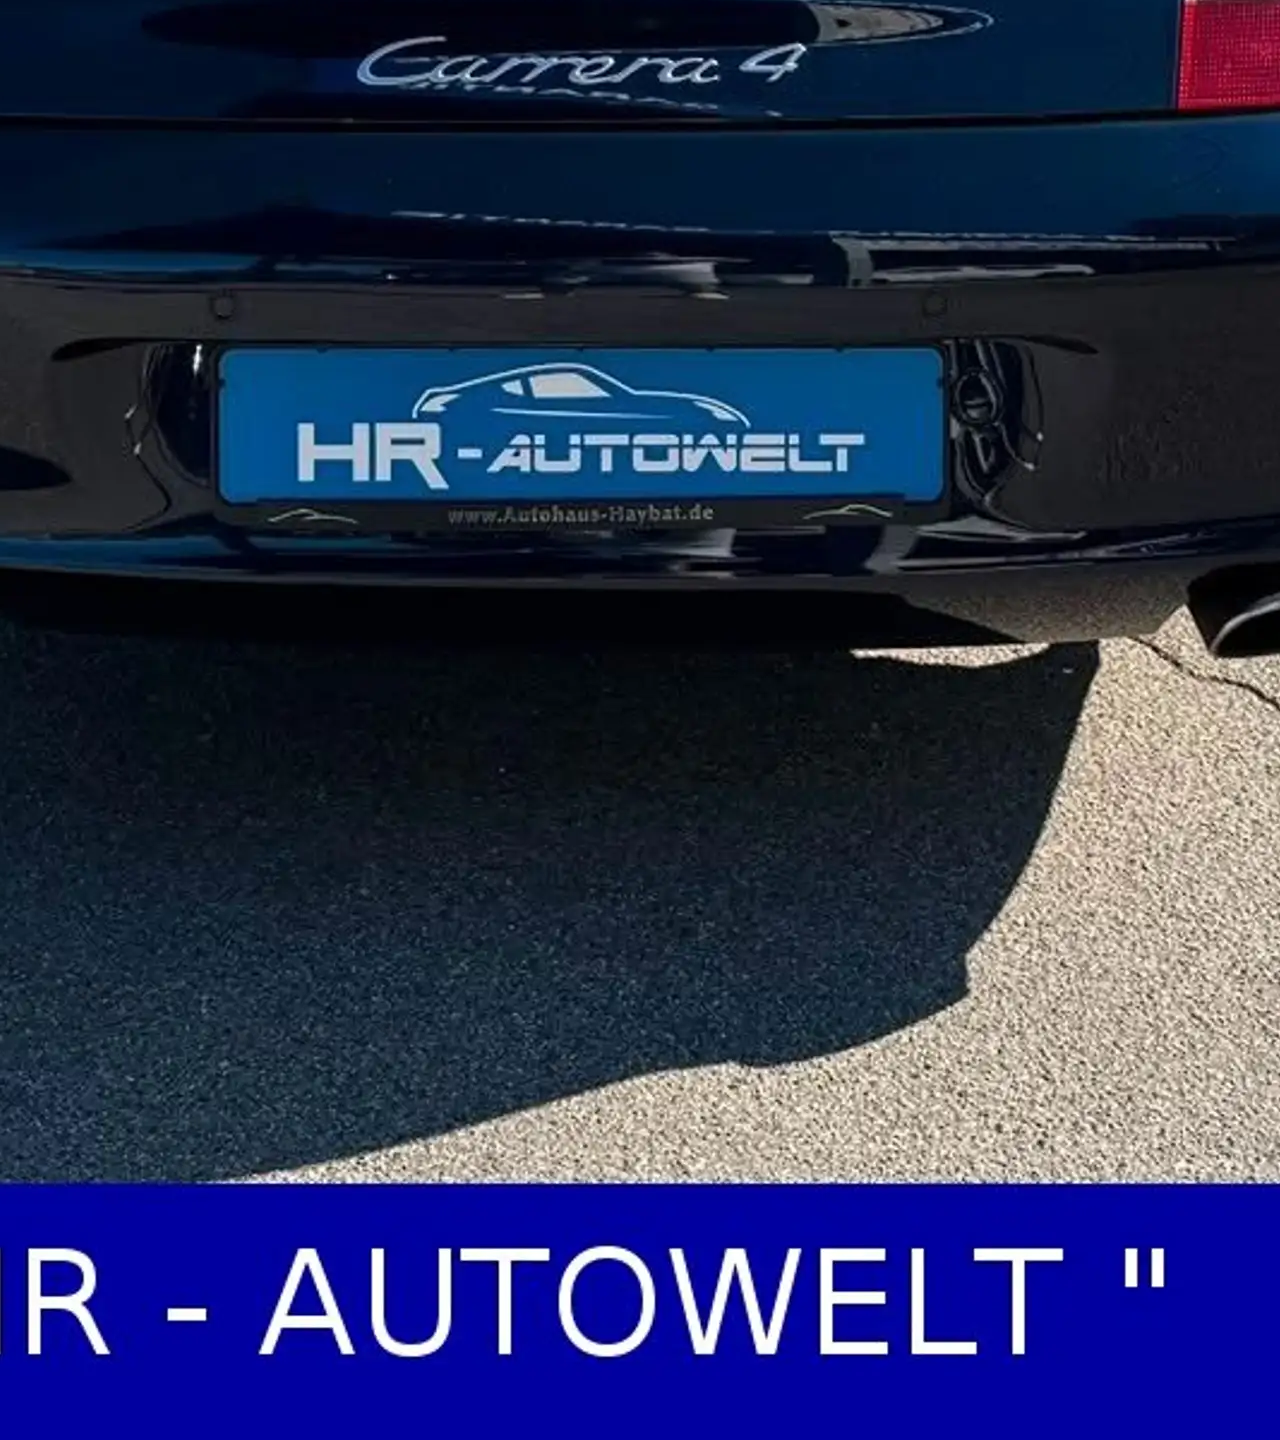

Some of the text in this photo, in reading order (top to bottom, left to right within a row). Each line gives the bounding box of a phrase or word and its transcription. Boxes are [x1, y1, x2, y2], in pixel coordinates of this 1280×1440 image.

[356, 36, 807, 85] Carrera 4
[448, 505, 714, 525] www.Autohaus-Haybat.de
